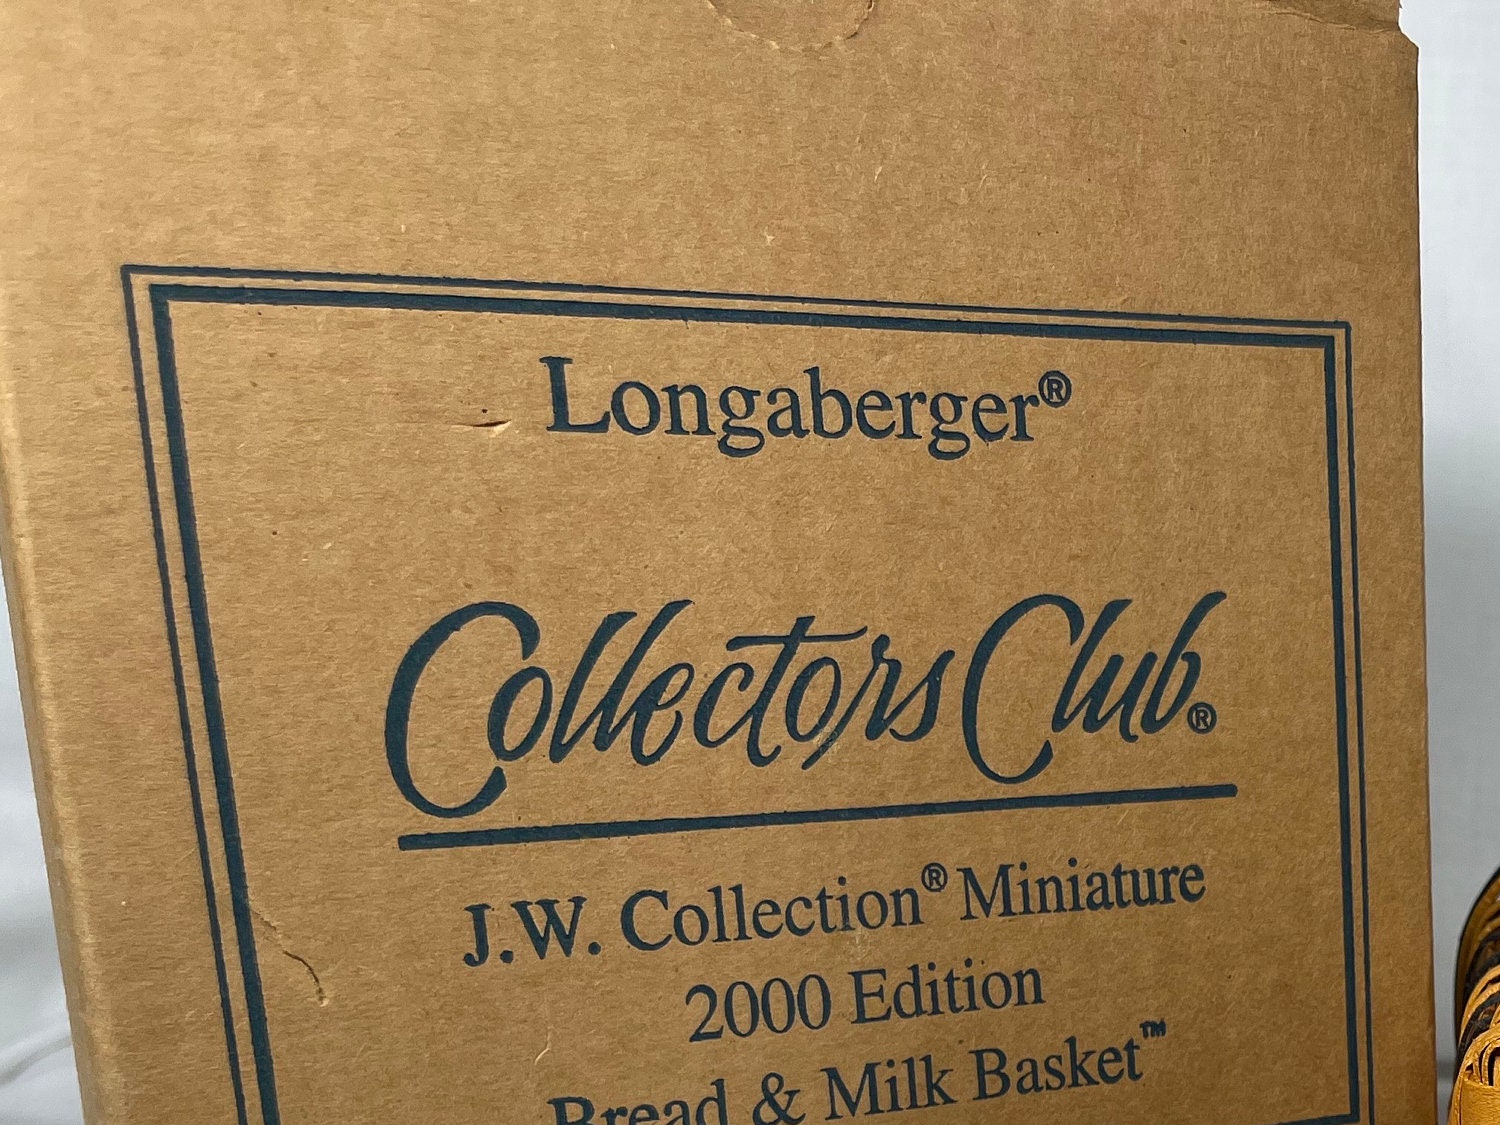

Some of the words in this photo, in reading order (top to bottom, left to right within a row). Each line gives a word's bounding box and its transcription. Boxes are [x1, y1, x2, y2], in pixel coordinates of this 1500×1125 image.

[541, 355, 1072, 460] Longaberger®
[385, 600, 955, 819] Collectors
[962, 591, 1228, 785] Club®
[463, 897, 601, 967] J.W.
[620, 862, 950, 952] Collection®
[959, 856, 1207, 921] Miniature
[686, 974, 833, 1043] 2000
[847, 959, 1046, 1023] Edition
[824, 1055, 954, 1124] Milk
[974, 1021, 1168, 1102] Basket™
